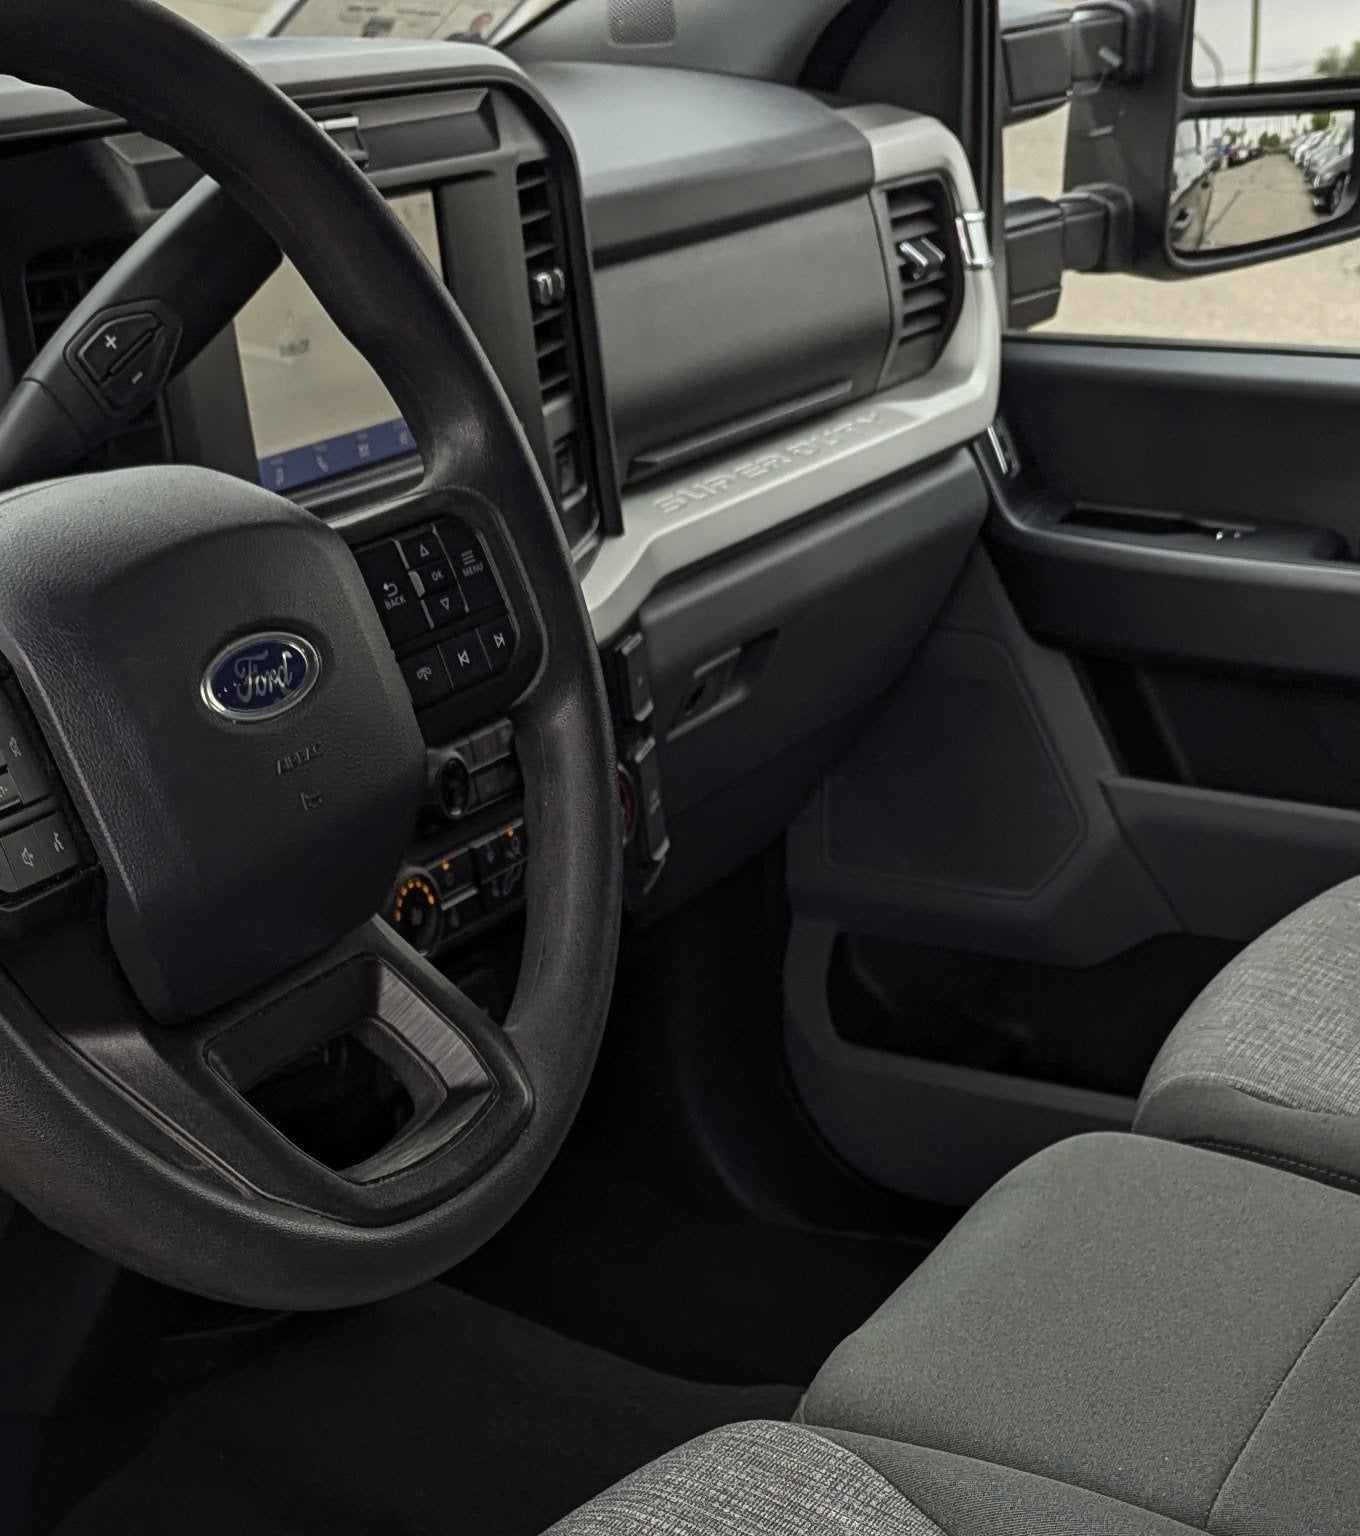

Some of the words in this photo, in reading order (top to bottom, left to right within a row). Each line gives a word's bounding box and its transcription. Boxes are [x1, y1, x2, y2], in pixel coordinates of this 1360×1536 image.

[431, 569, 444, 582] OK
[462, 562, 484, 578] MENU
[384, 594, 407, 611] BACK
[234, 650, 293, 704] Ford
